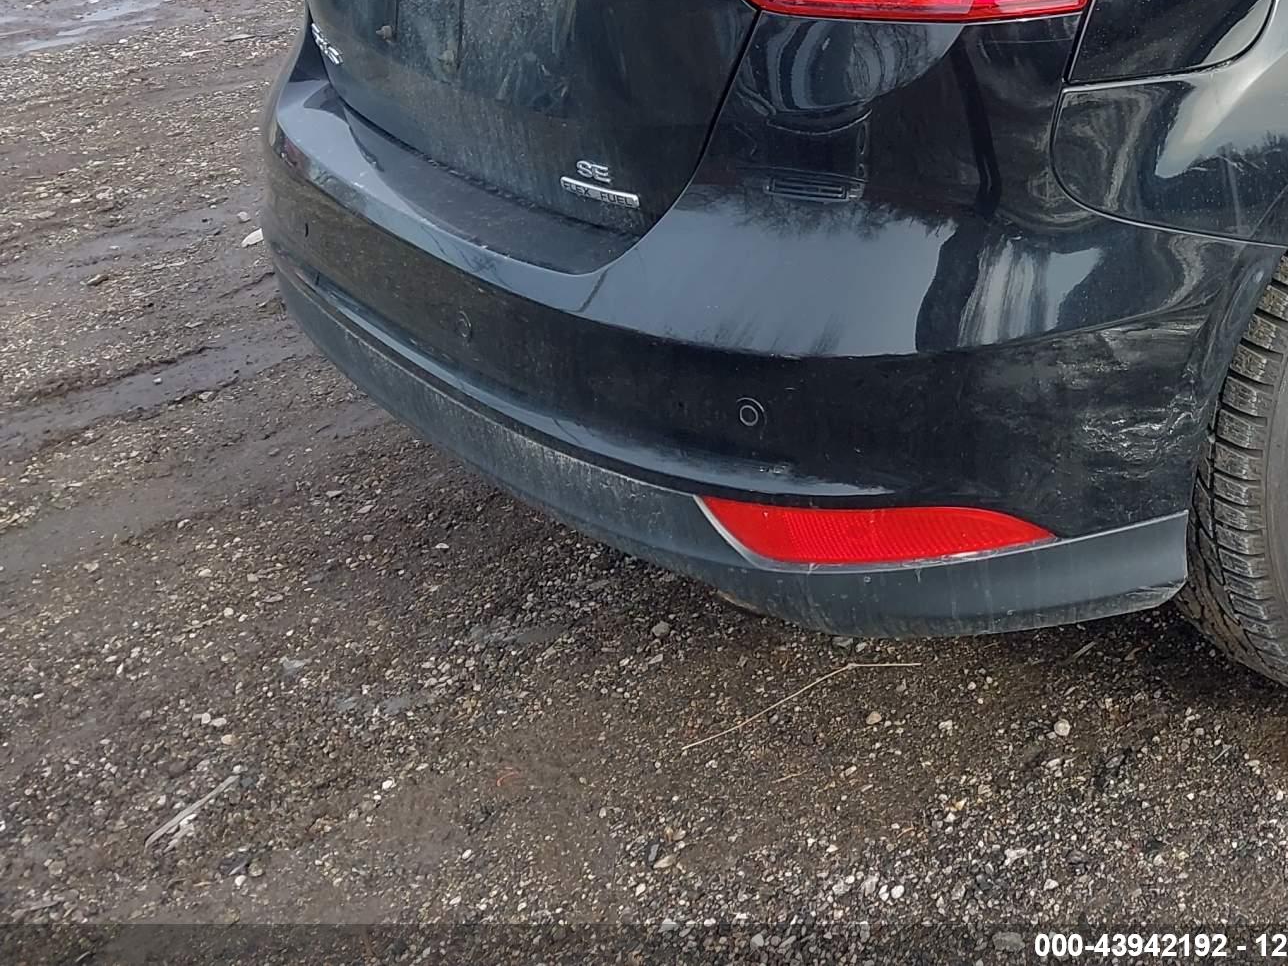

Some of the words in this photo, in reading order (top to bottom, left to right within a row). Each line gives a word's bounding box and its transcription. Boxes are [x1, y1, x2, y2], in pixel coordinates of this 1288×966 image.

[576, 160, 611, 183] SE
[562, 182, 591, 197] FLEX
[600, 192, 634, 207] FUEL
